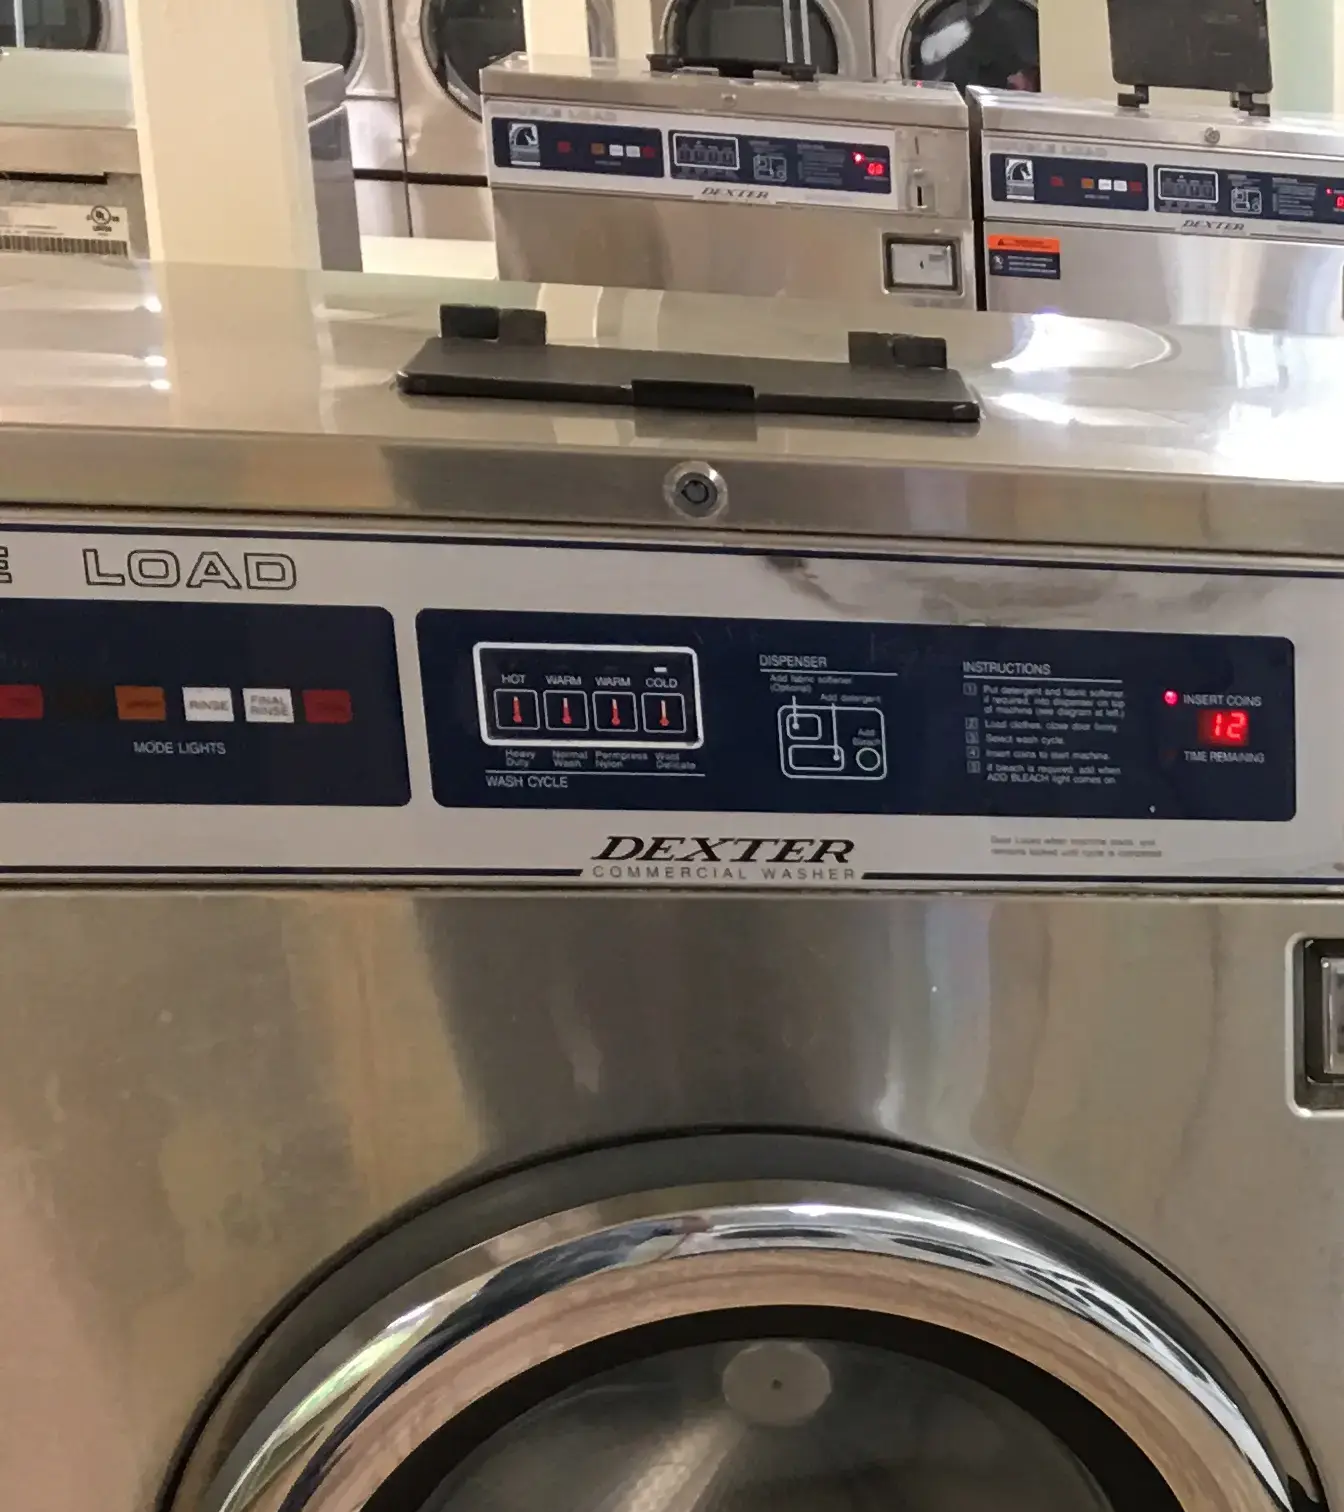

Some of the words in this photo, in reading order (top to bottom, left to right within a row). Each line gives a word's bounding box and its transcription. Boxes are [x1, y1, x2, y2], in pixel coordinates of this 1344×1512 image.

[82, 547, 297, 590] LOAD
[759, 654, 827, 667] DISPENSER
[962, 661, 1051, 675] INSTRUCTIONS
[501, 674, 526, 684] HOT
[544, 675, 582, 685] WARM
[595, 676, 631, 686] WARM
[645, 677, 678, 688] COLD
[770, 674, 787, 683] Add
[189, 700, 229, 712] RINSE
[1183, 694, 1224, 705] INSERT
[1226, 695, 1262, 707] COINS
[985, 720, 1007, 728] Load
[1215, 712, 1246, 740] 12
[985, 734, 1013, 743] Select
[133, 741, 174, 754] MODE
[178, 742, 226, 755] LIGHTS
[1184, 751, 1208, 762] TIME
[1209, 751, 1265, 763] REMAINING
[485, 776, 523, 787] WASH
[528, 776, 568, 788] CYCLE
[987, 773, 1008, 781] ADD
[1011, 774, 1049, 782] BLEACH
[590, 835, 855, 864] DEXTER
[592, 865, 748, 880] COMMERCIAL
[761, 868, 856, 881] WASHER
